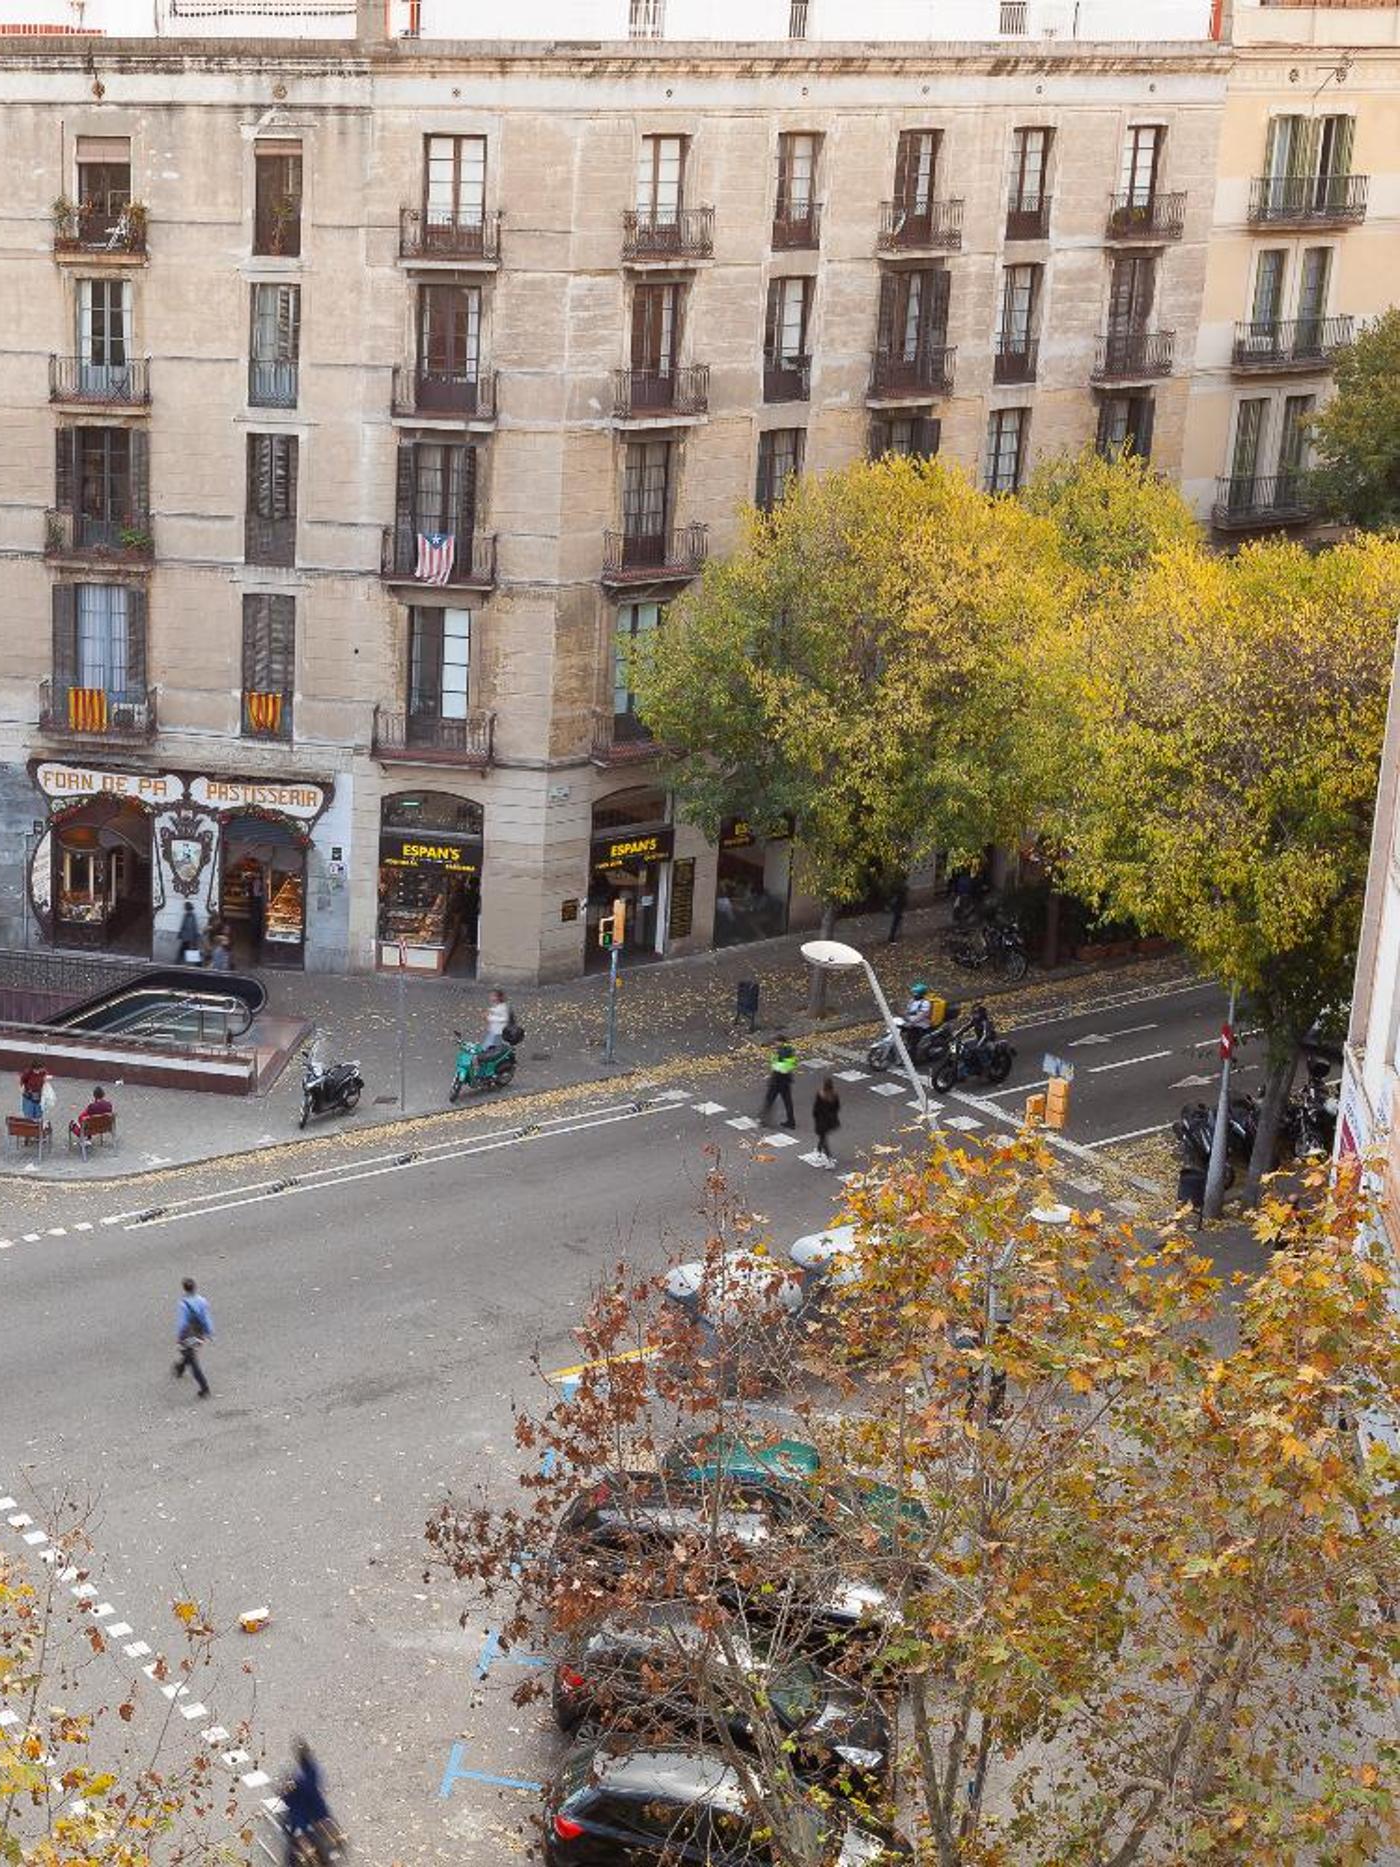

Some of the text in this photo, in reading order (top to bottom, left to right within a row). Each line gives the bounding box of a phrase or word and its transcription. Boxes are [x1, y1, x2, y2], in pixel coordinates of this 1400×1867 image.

[42, 770, 167, 796] FORN DE PA
[206, 782, 317, 808] PASTISSERIA
[402, 843, 462, 861] ESPAN'S
[610, 837, 658, 858] ESPAN'S
